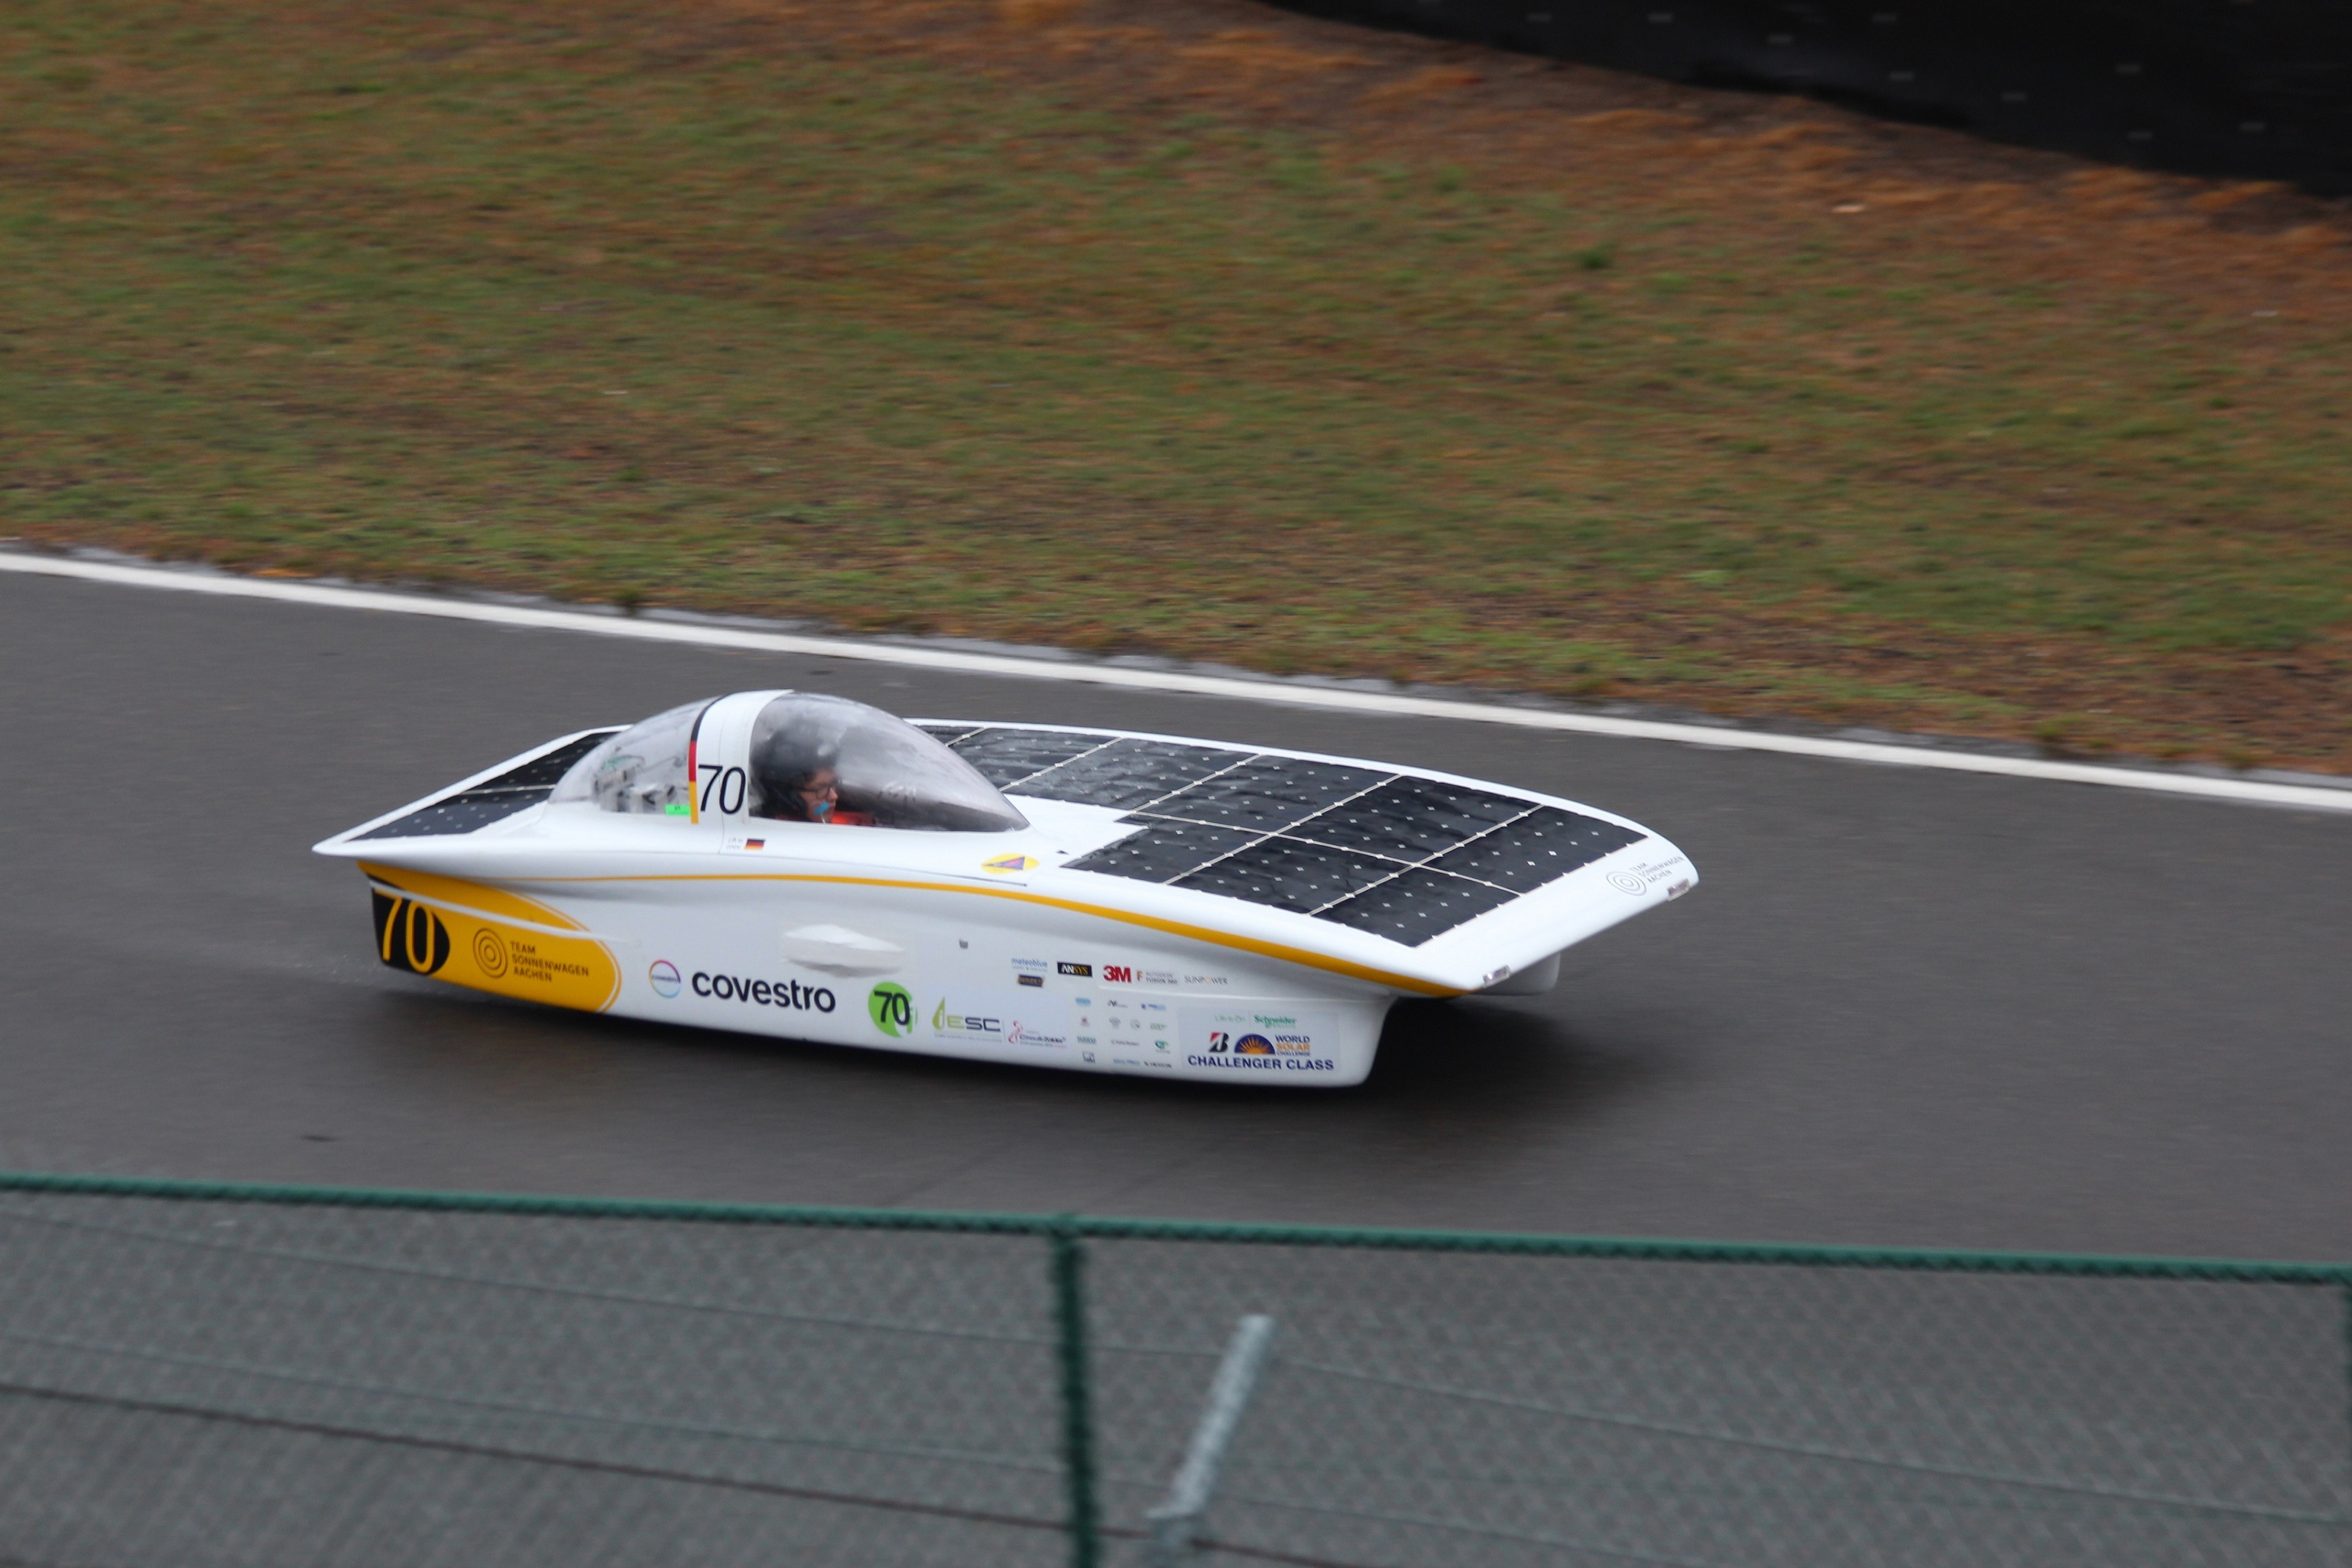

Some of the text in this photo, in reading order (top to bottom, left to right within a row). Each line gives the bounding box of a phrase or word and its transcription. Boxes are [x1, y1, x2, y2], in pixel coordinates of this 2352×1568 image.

[698, 764, 746, 815] 70
[374, 887, 435, 974] 70
[511, 941, 536, 955] TEAM
[512, 954, 589, 977] SONNENWAGEN
[1061, 964, 1088, 974] ANSYS
[1104, 965, 1132, 983] 3M
[514, 967, 552, 982] AACHEN
[692, 972, 835, 1013] covestro
[873, 989, 910, 1026] 70
[1275, 1034, 1310, 1043] WORLD
[1276, 1043, 1310, 1051] SOLAR
[1188, 1054, 1334, 1070] CHALLENGER CLASS
